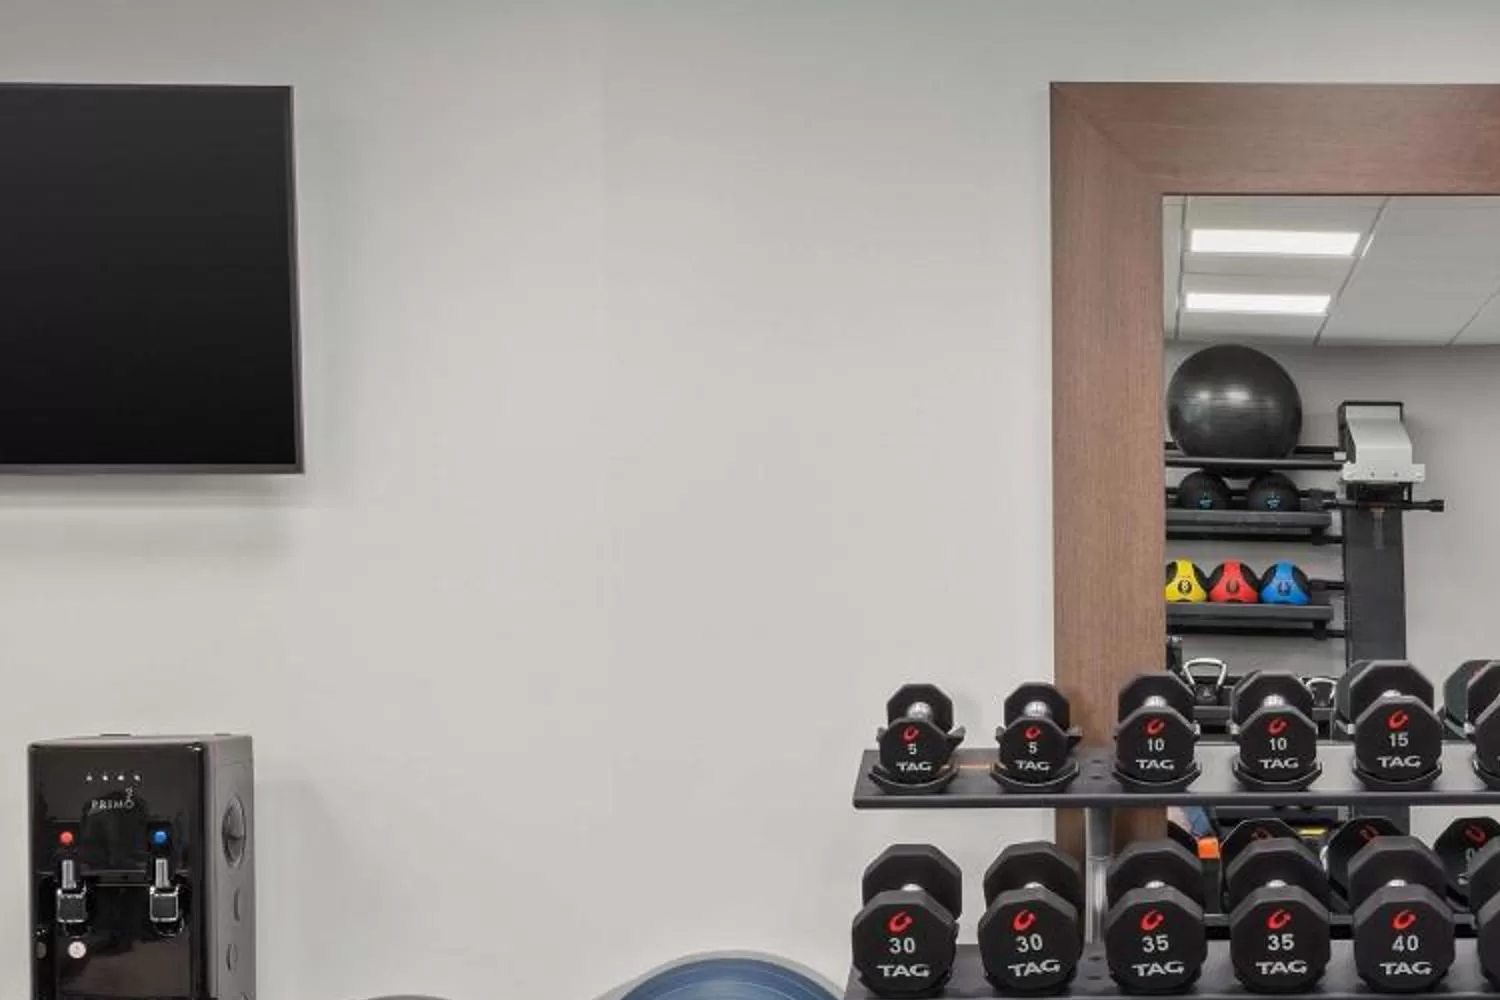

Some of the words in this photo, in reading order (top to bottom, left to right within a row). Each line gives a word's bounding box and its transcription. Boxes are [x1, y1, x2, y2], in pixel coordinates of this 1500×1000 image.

[1147, 738, 1165, 753] 10
[1269, 737, 1288, 751] 10
[1389, 731, 1409, 748] 15
[908, 742, 918, 756] 5
[1028, 740, 1038, 755] 5
[896, 760, 933, 772] TAG
[1015, 759, 1051, 772] TAG
[1135, 759, 1175, 771] TAG
[1259, 757, 1299, 769] TAG
[1376, 755, 1421, 768] TAG
[889, 937, 916, 955] 30
[1015, 933, 1043, 953] 30
[1142, 934, 1169, 953] 35
[1267, 933, 1295, 951] 35
[1391, 934, 1419, 952] 40
[876, 963, 930, 978] TAG
[1007, 958, 1061, 977] TAG
[1131, 960, 1185, 977] TAG
[1255, 959, 1308, 975] TAG
[1379, 961, 1432, 976] TAG
